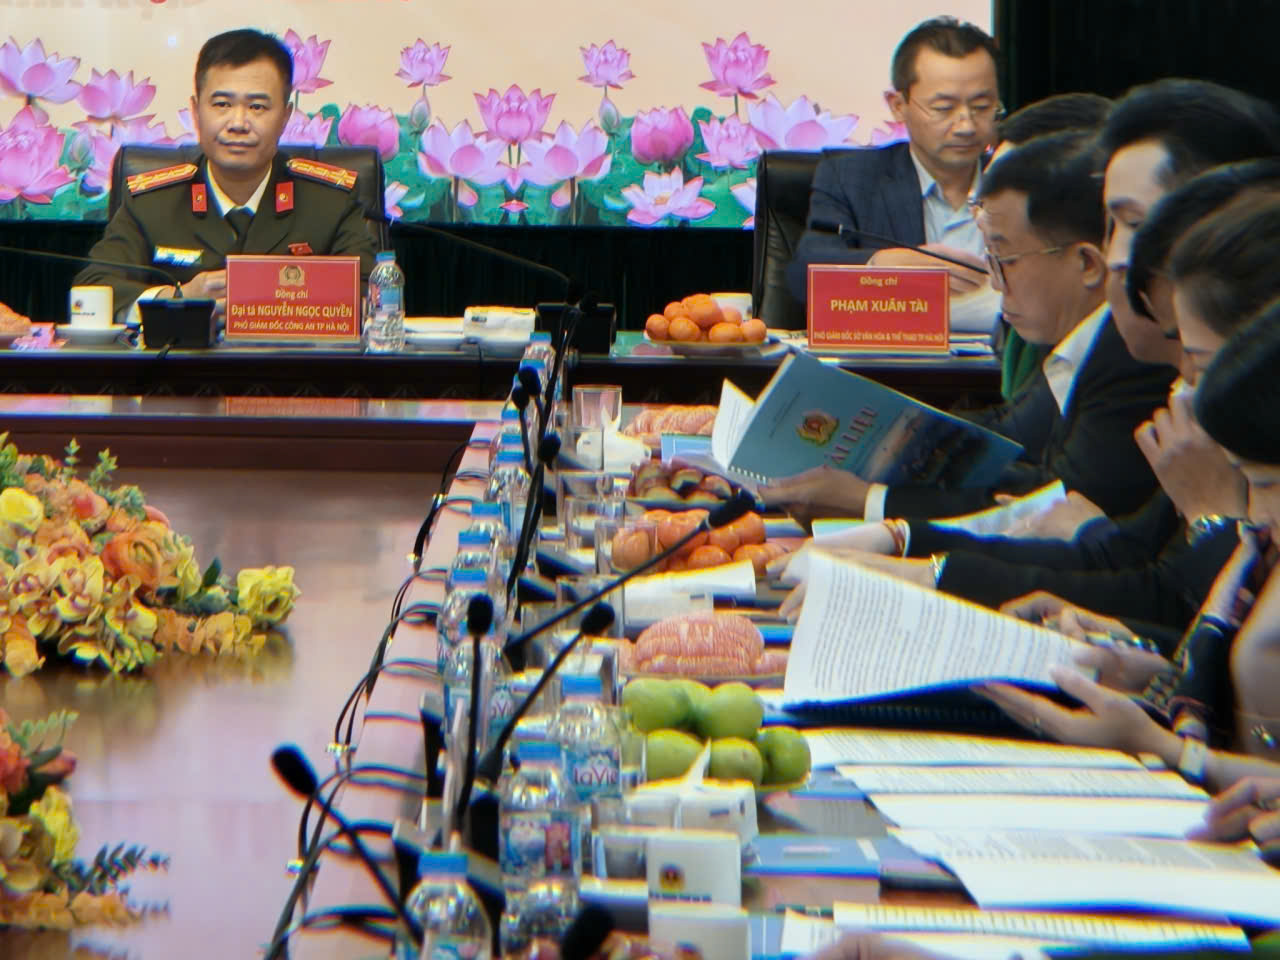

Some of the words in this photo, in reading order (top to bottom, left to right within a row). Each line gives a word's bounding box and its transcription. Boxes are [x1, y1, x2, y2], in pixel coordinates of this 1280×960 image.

[860, 276, 883, 287] Đồng
[885, 276, 898, 286] chí
[275, 288, 296, 300] Đồng
[296, 289, 308, 299] chí
[231, 304, 245, 317] Đại
[247, 305, 256, 316] tá
[257, 301, 293, 316] NGUYỄN
[296, 305, 320, 318] NGỌC
[830, 298, 868, 314] PHẠM
[871, 297, 907, 312] XUÂN
[909, 298, 928, 313] TÀI
[233, 320, 248, 330] PHÓ
[285, 320, 304, 330] CÔNG
[326, 321, 336, 330] HÀ
